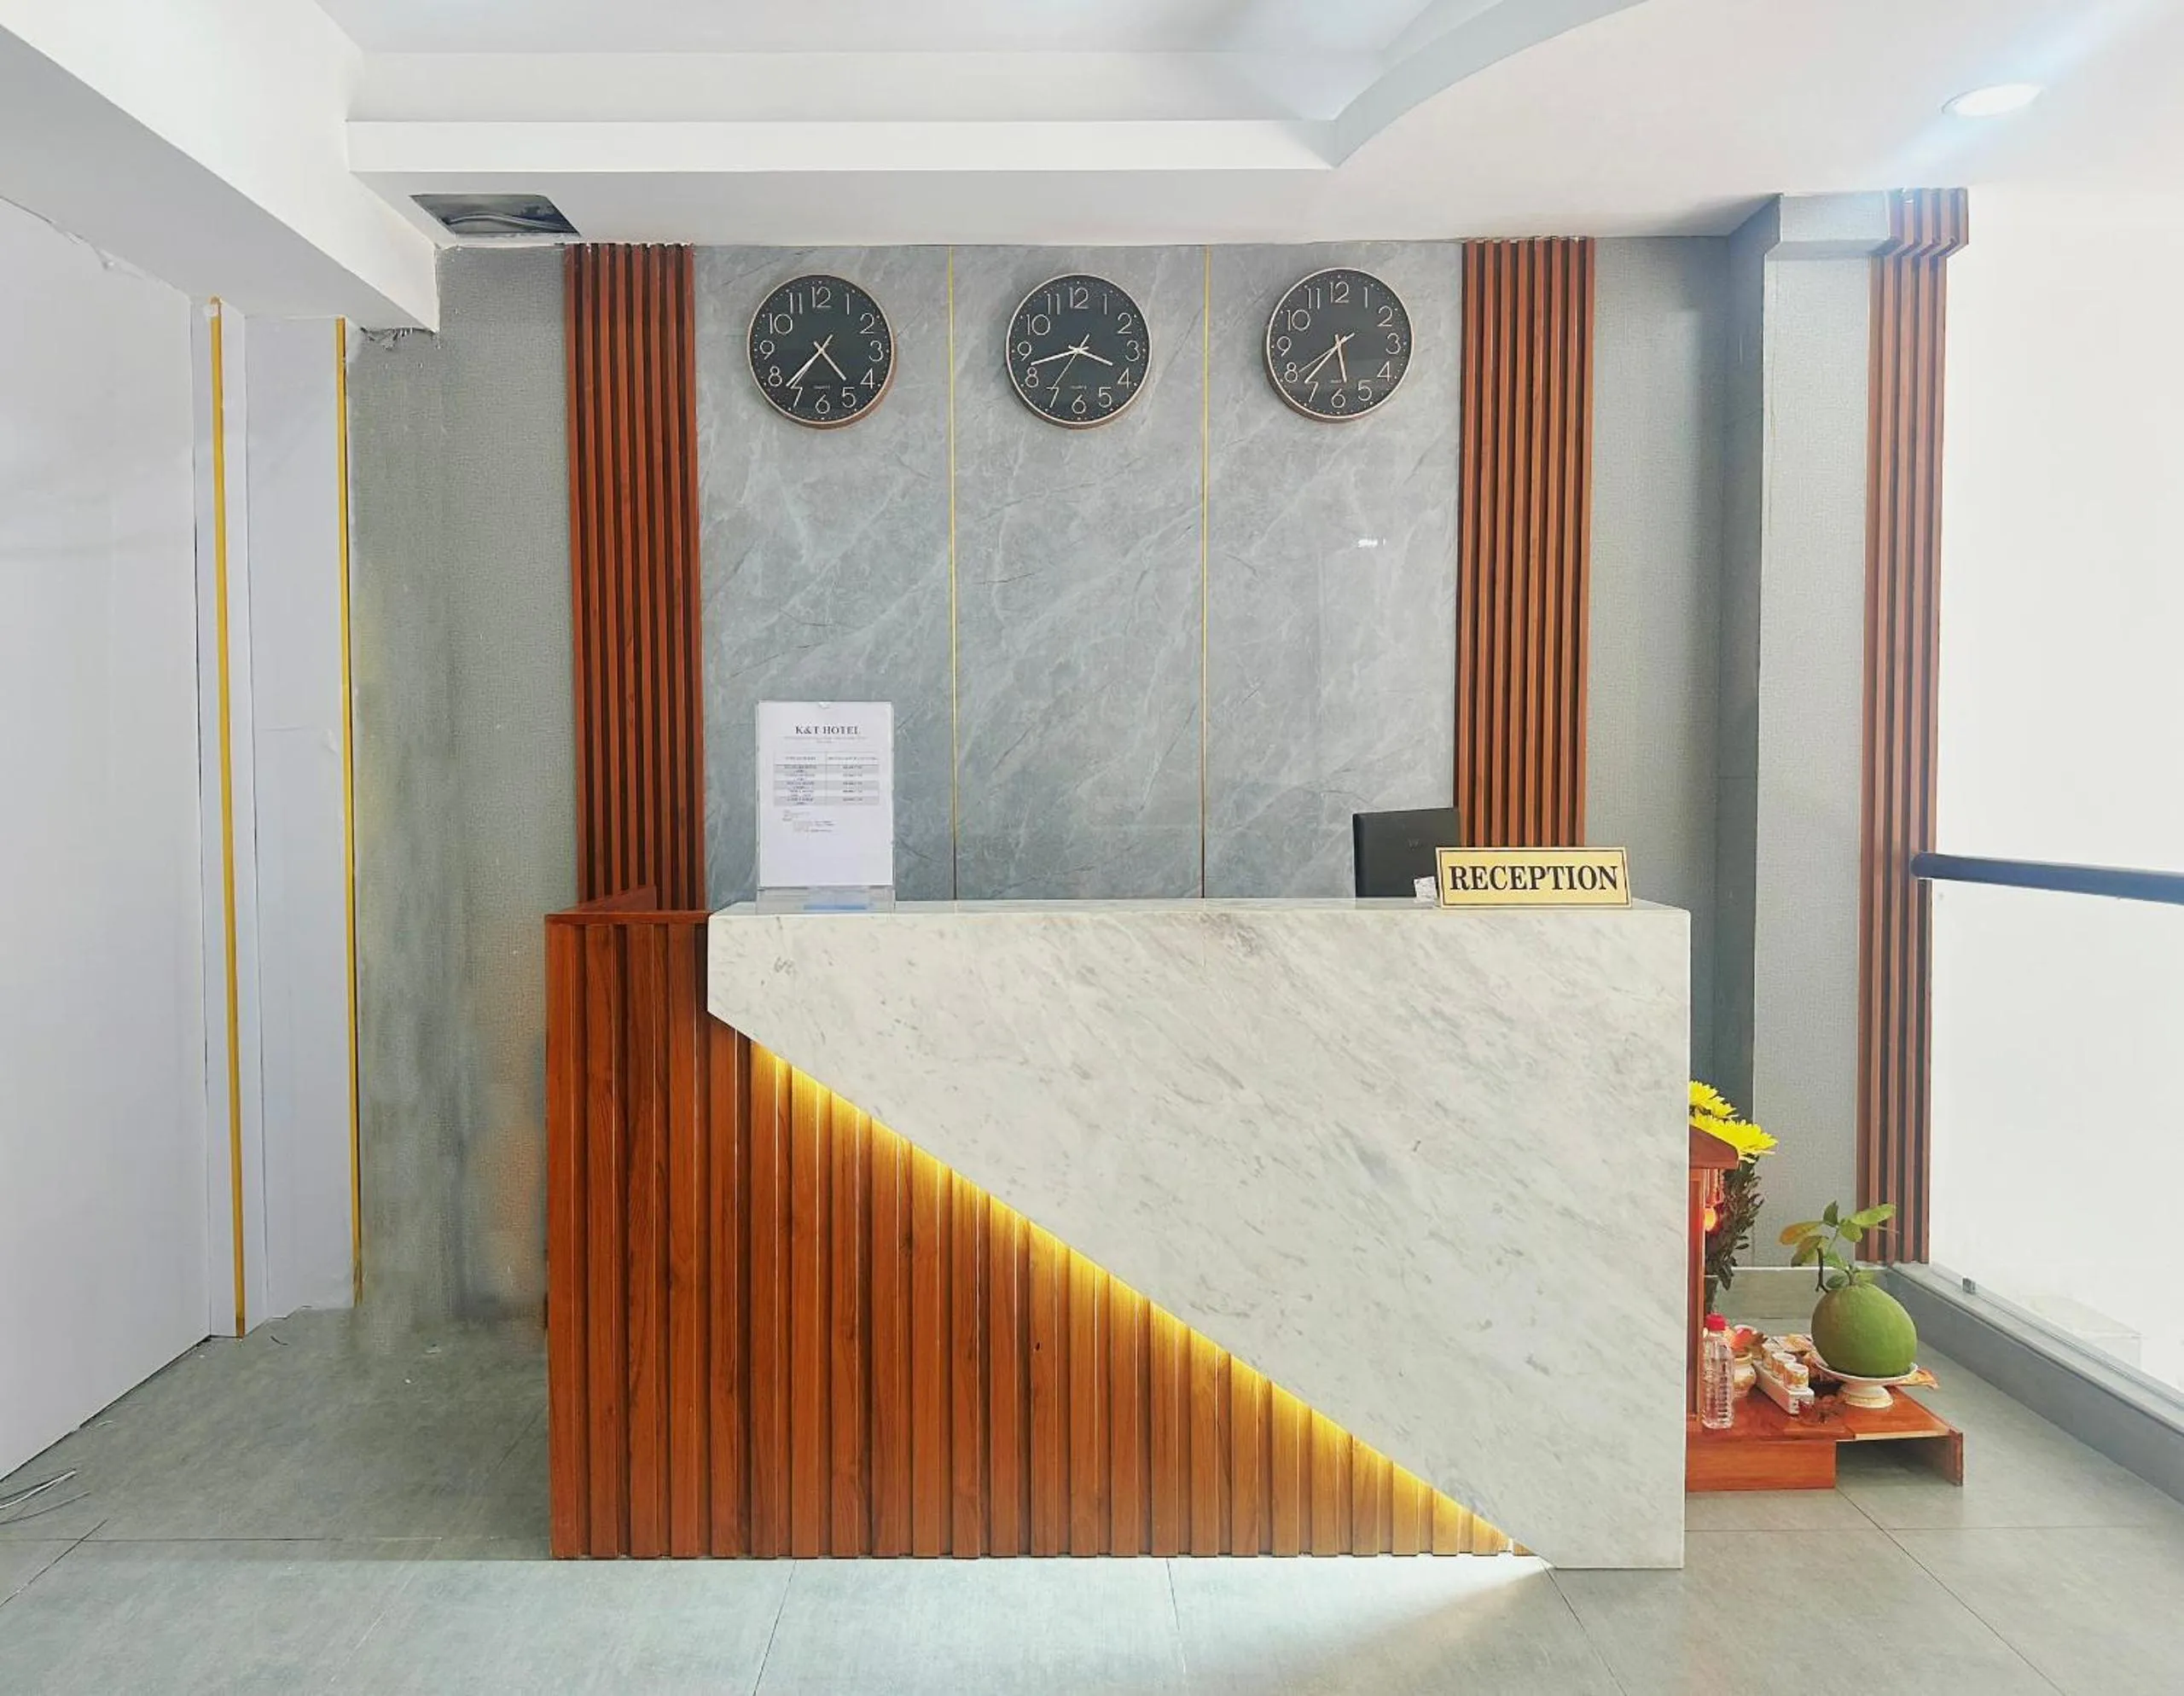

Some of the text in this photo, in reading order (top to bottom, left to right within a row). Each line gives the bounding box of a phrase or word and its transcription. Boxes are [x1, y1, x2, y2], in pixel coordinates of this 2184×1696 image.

[811, 286, 831, 308] 12
[1069, 287, 1089, 310] 12
[1307, 288, 1320, 310] 11
[1330, 281, 1350, 303] 12
[1363, 287, 1368, 309] 1
[789, 292, 803, 315] 11
[846, 293, 850, 315] 1
[1047, 293, 1060, 315] 11
[1103, 293, 1107, 315] 1
[769, 313, 793, 334] 10
[859, 312, 874, 334] 2
[1025, 314, 1051, 335] 10
[1118, 312, 1133, 334] 2
[1287, 309, 1310, 331] 10
[1377, 305, 1393, 327] 2
[759, 340, 775, 360] 9
[868, 340, 884, 362] 3
[1017, 340, 1031, 362] 9
[1124, 340, 1141, 362] 3
[1276, 335, 1292, 357] 9
[1385, 333, 1401, 354] 3
[768, 366, 783, 387] 8
[859, 368, 875, 389] 4
[1025, 366, 1039, 388] 8
[1117, 367, 1131, 389] 4
[1284, 362, 1298, 383] 8
[1376, 361, 1392, 381] 4
[790, 386, 803, 408] 7
[842, 386, 857, 408] 5
[1046, 386, 1060, 409] 7
[1098, 386, 1112, 408] 5
[1305, 380, 1319, 403] 7
[1331, 388, 1346, 409] 6
[1357, 380, 1373, 401] 5
[815, 394, 830, 414] 6
[1071, 394, 1087, 415] 6
[795, 725, 861, 735] K&T HOTEL
[1449, 865, 1618, 891] RECEPTION
